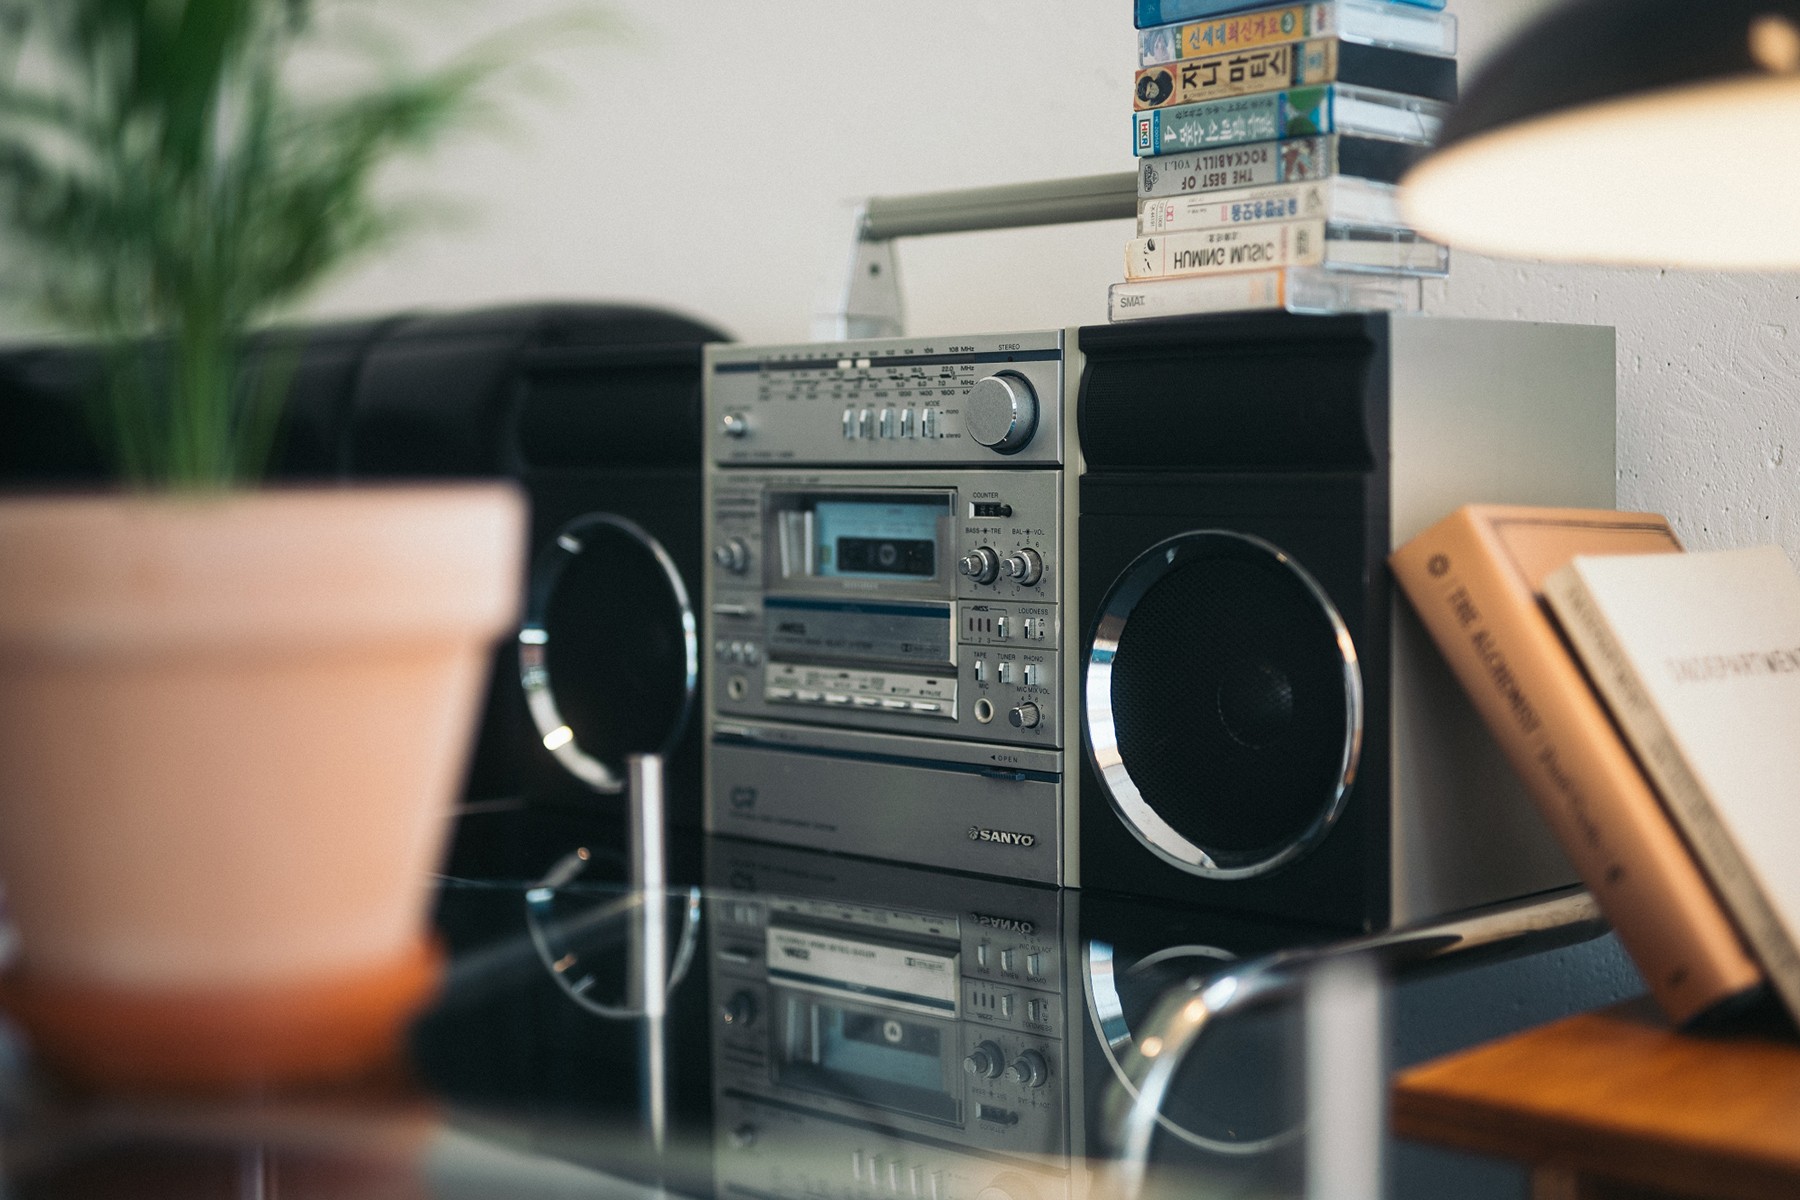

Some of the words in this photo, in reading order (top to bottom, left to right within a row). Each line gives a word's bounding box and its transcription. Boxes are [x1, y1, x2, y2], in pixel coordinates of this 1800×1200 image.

[1141, 122, 1149, 146] HKR
[1195, 149, 1269, 171] ROCKABILLY
[1181, 176, 1197, 190] OF
[1202, 172, 1227, 188] BEST
[1233, 170, 1254, 185] THE
[1018, 607, 1049, 616] LOUDNESS
[997, 652, 1016, 660] TUNER
[1023, 654, 1044, 663] PHONO
[978, 682, 989, 690] MIC
[997, 755, 1018, 763] OPEN
[979, 829, 1035, 847] SANYO
